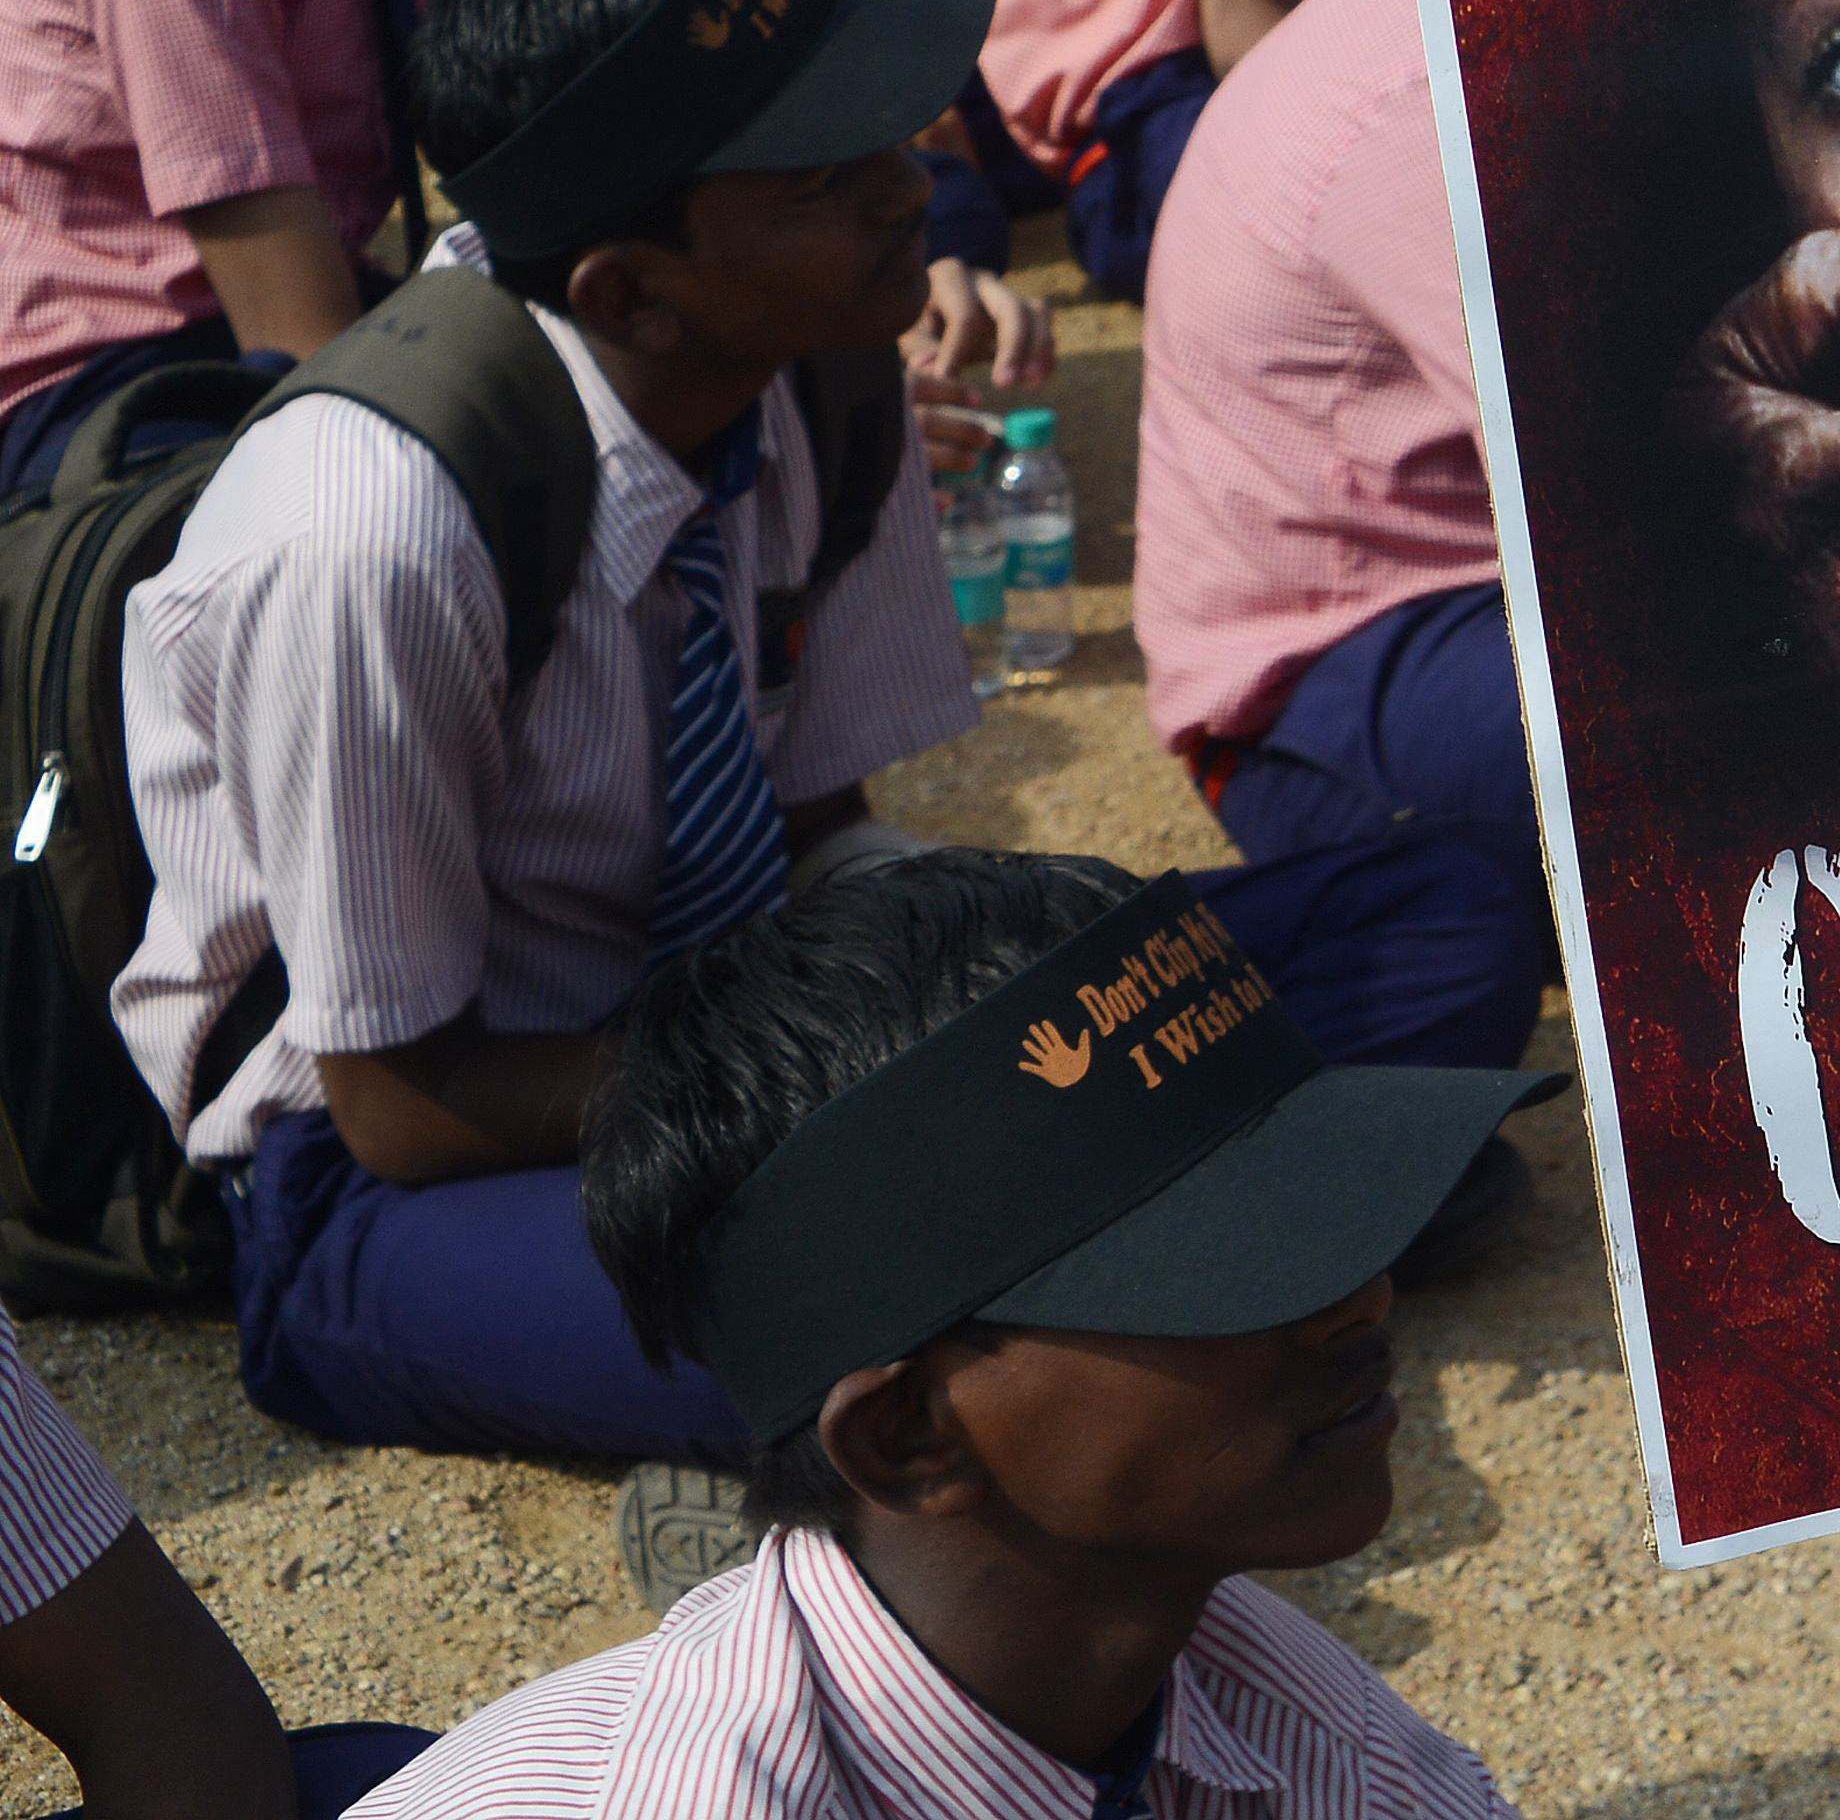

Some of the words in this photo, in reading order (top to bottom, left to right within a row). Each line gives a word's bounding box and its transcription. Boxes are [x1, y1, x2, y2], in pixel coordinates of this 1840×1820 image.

[1075, 954, 1161, 1038] Don't
[1128, 1043, 1163, 1089] I
[1153, 988, 1243, 1065] Wish
